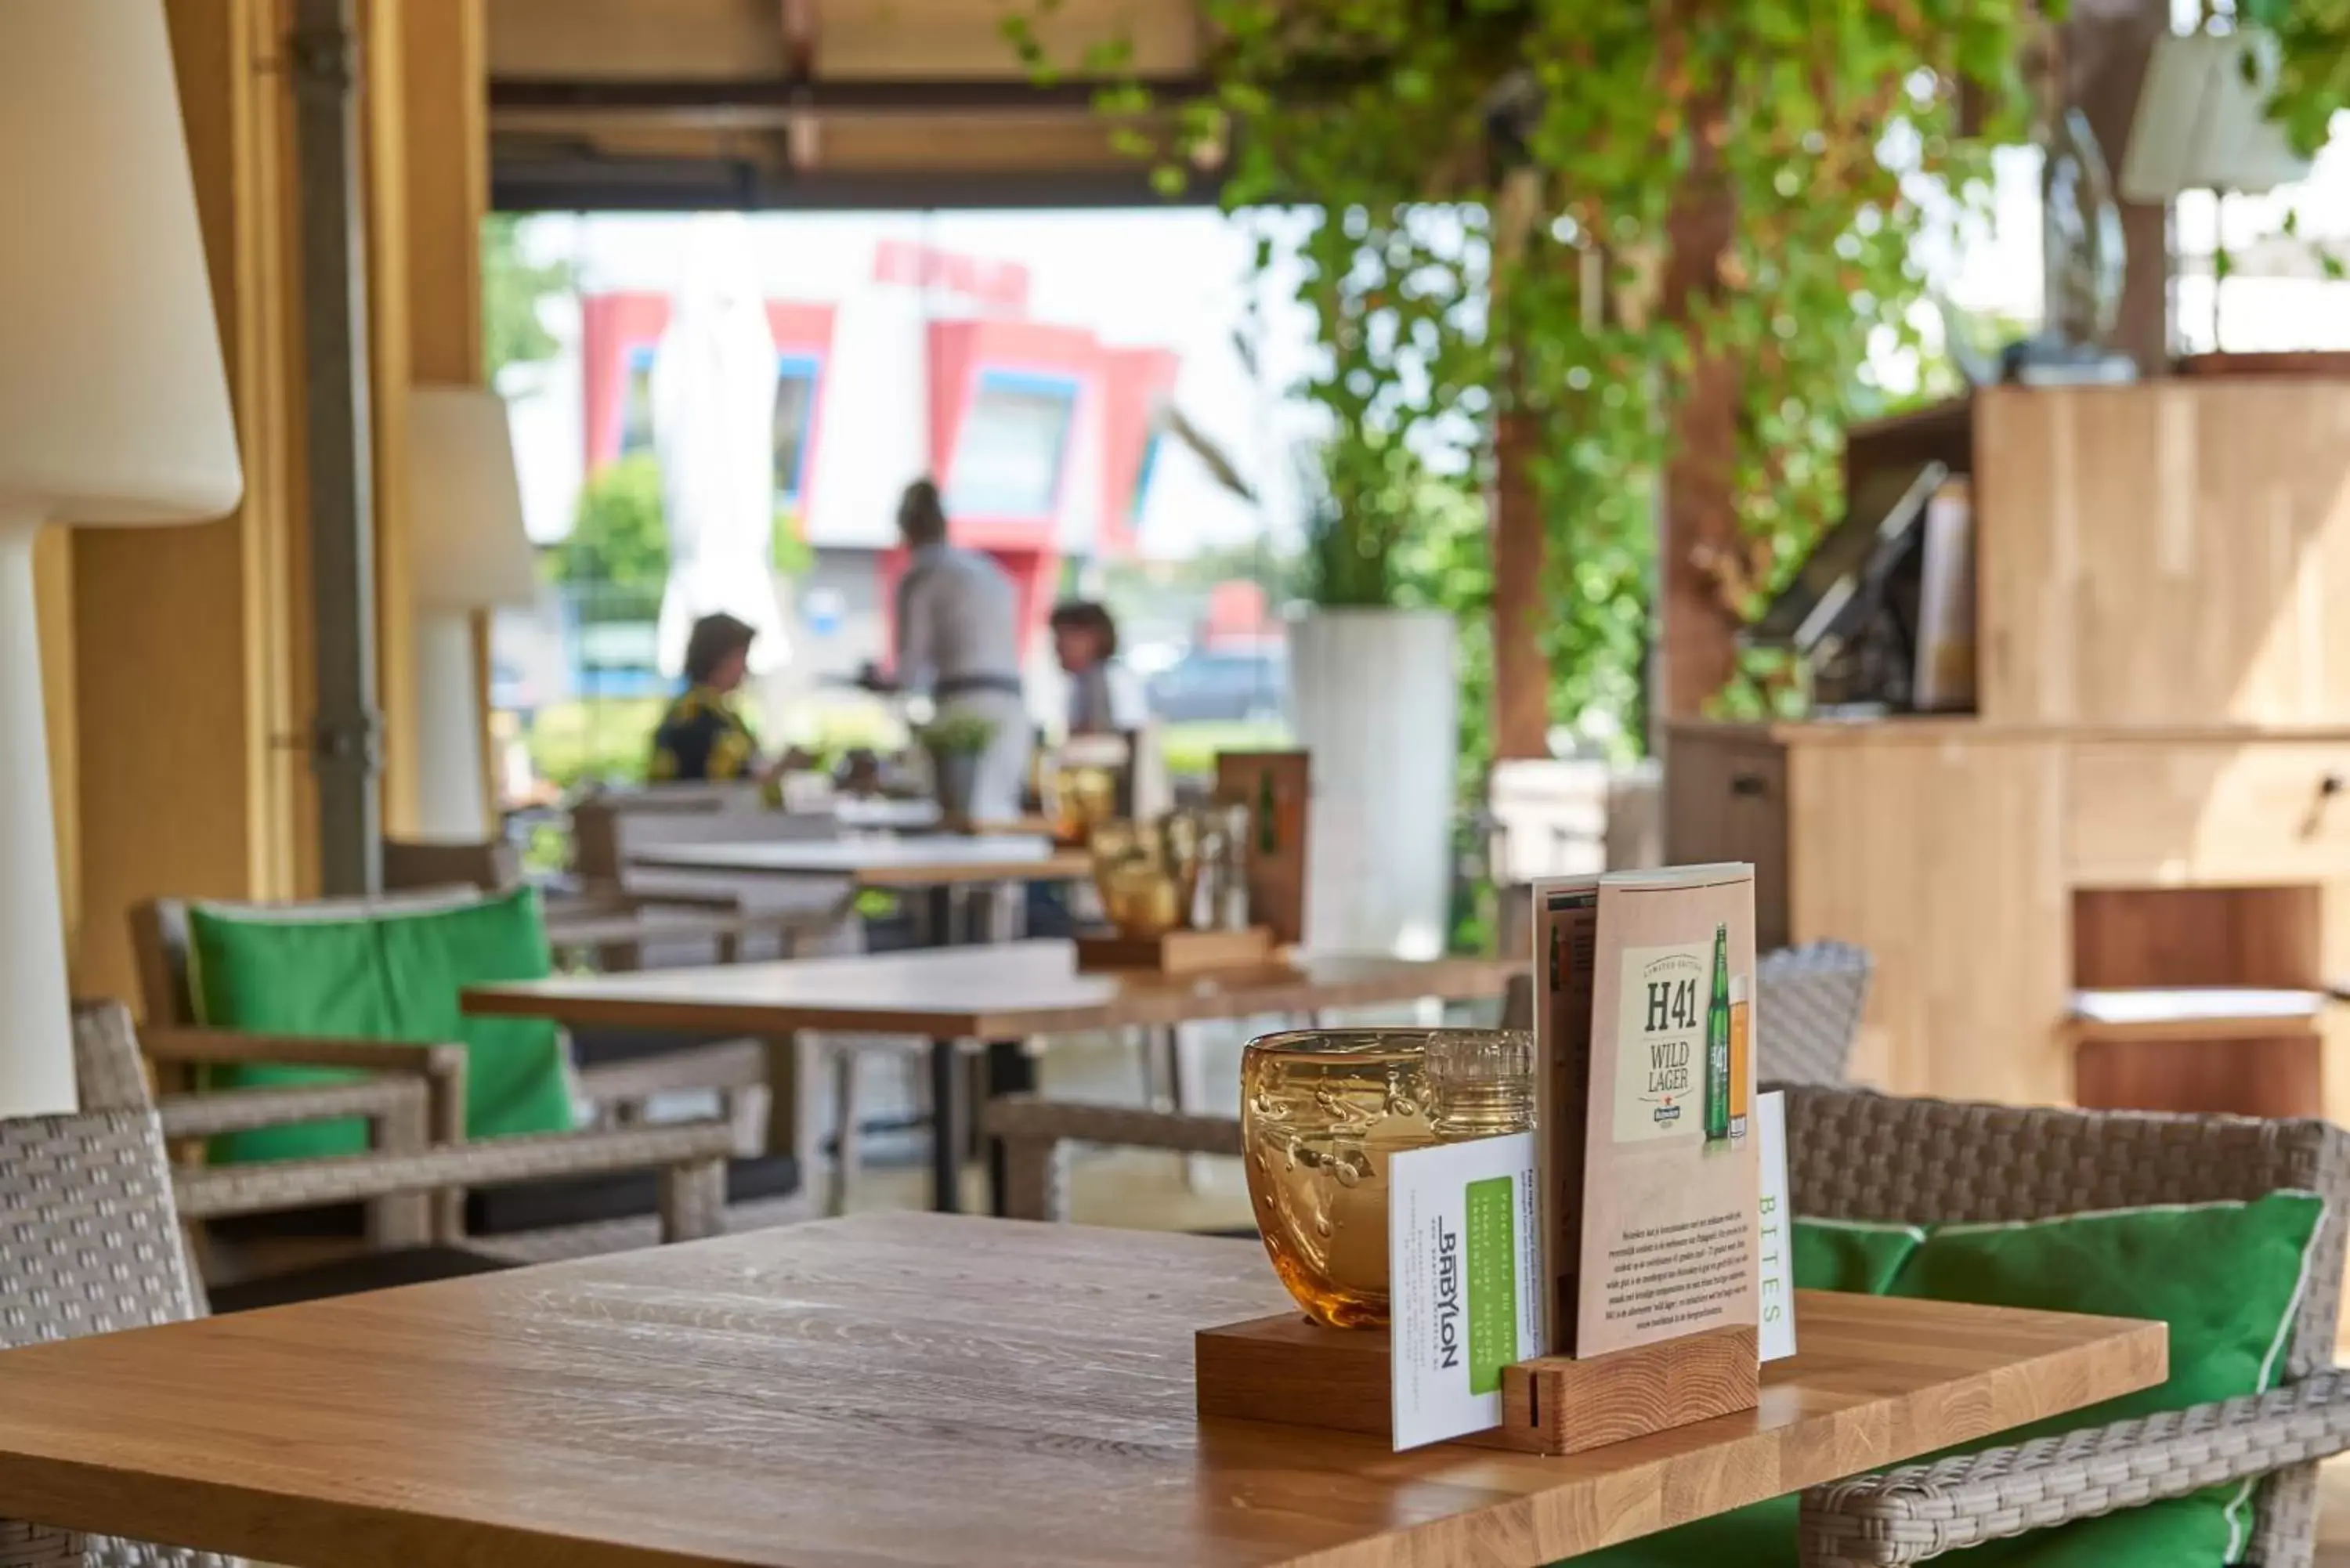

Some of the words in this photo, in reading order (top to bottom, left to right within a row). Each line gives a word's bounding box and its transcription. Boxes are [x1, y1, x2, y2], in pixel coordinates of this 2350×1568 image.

[1645, 978, 1697, 1031] H41
[1648, 1068, 1688, 1092] LAGER
[1650, 1041, 1689, 1070] WILD
[1759, 1194, 1781, 1324] BITES
[1438, 1215, 1459, 1369] BABYLON
